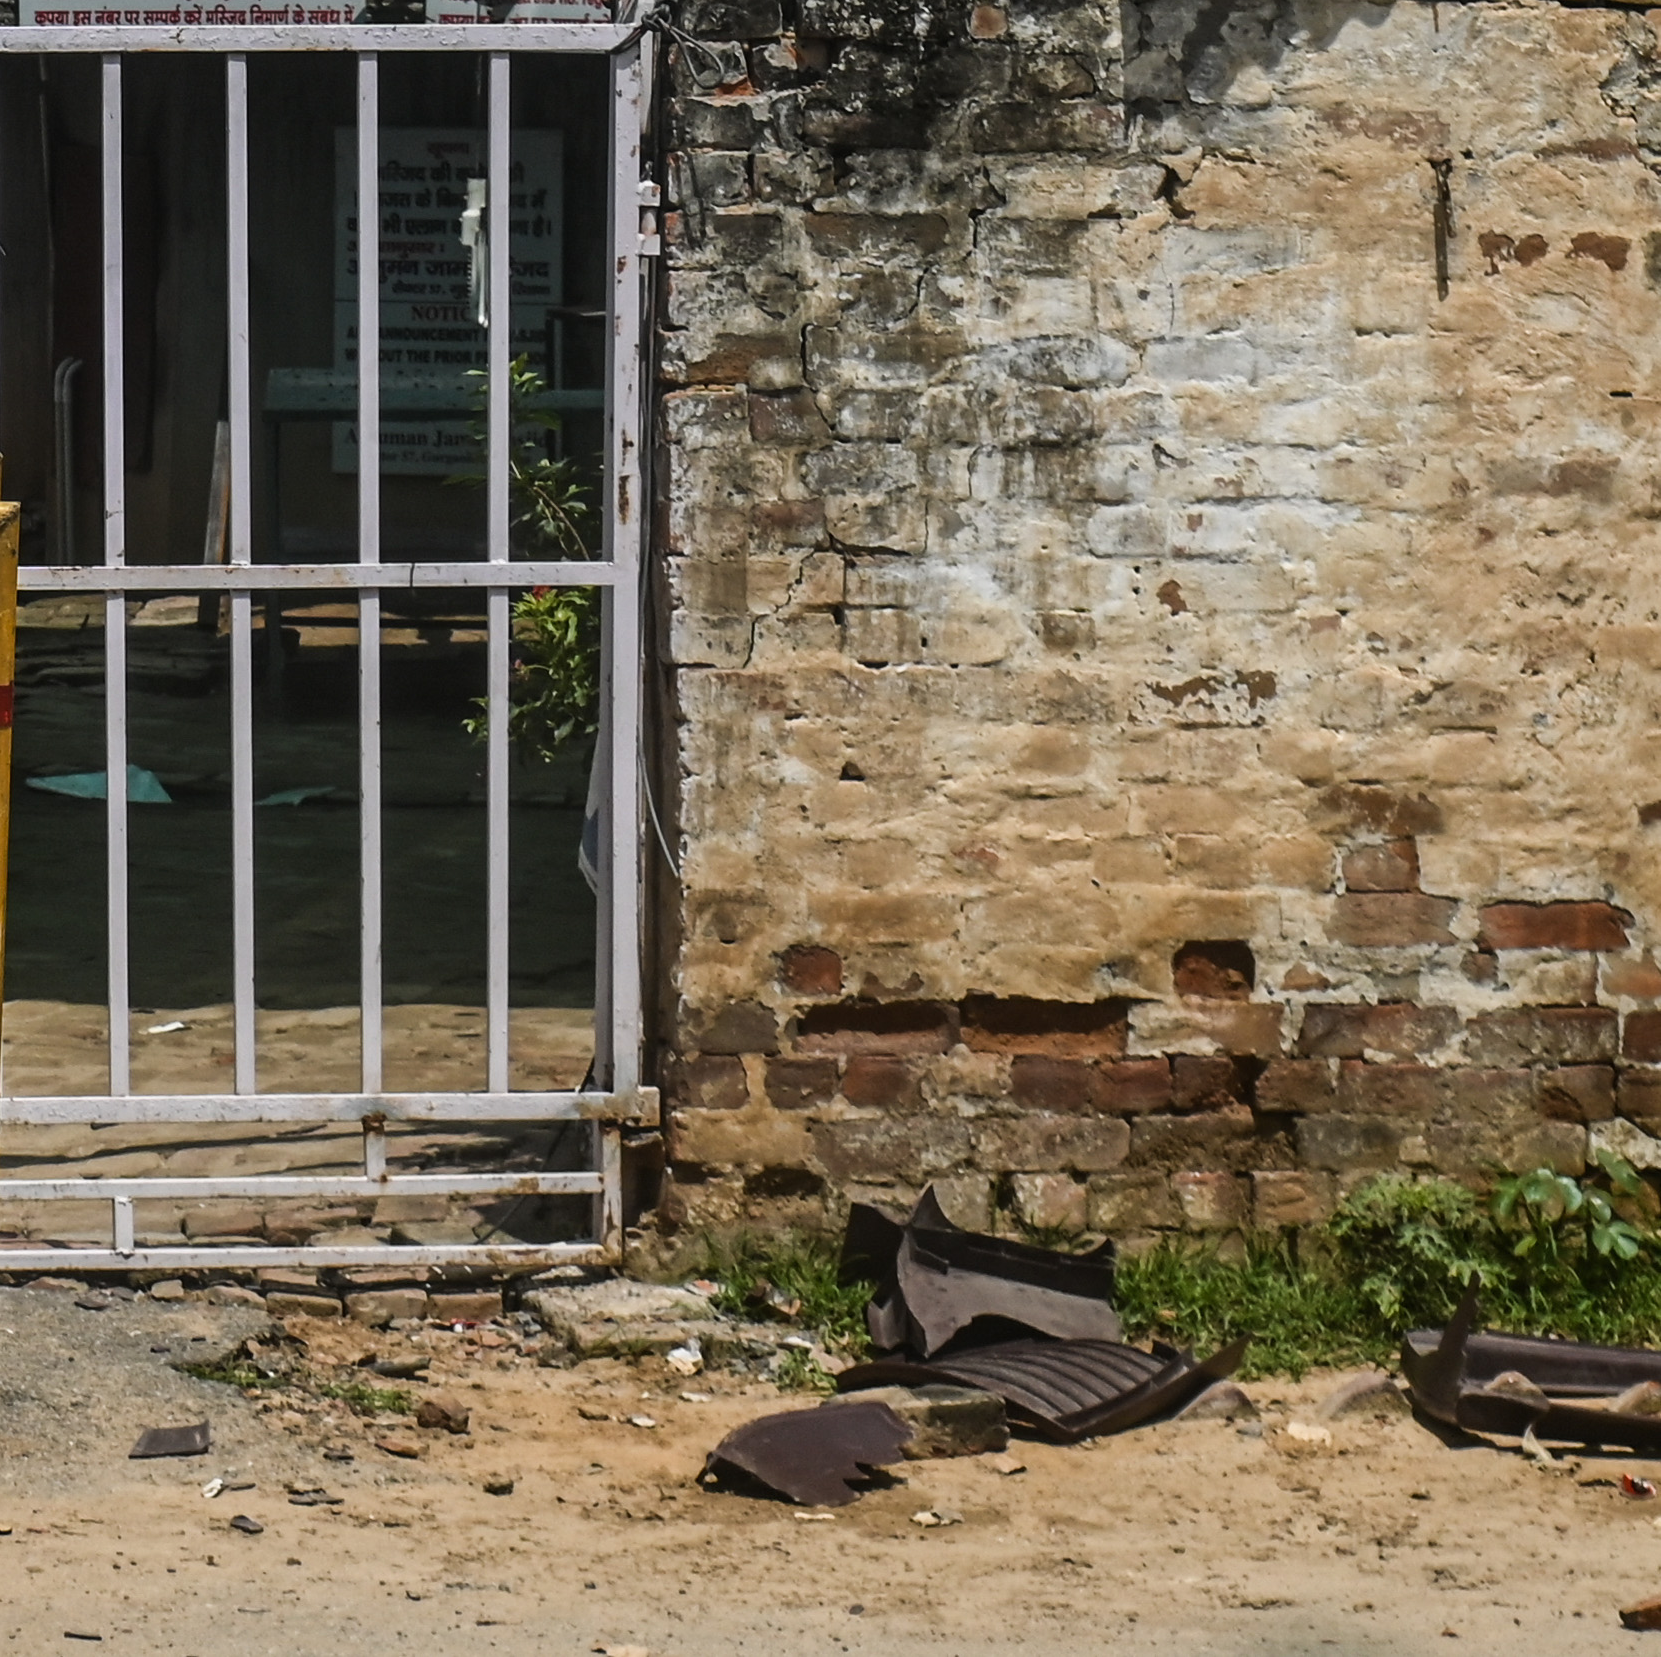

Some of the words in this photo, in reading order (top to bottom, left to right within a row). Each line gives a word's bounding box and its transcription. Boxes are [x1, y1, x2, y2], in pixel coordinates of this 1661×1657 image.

[35, 10, 69, 26] कपया
[95, 6, 121, 25] नंबर
[124, 10, 140, 25] पर
[184, 4, 203, 25] करें
[293, 4, 305, 24] के
